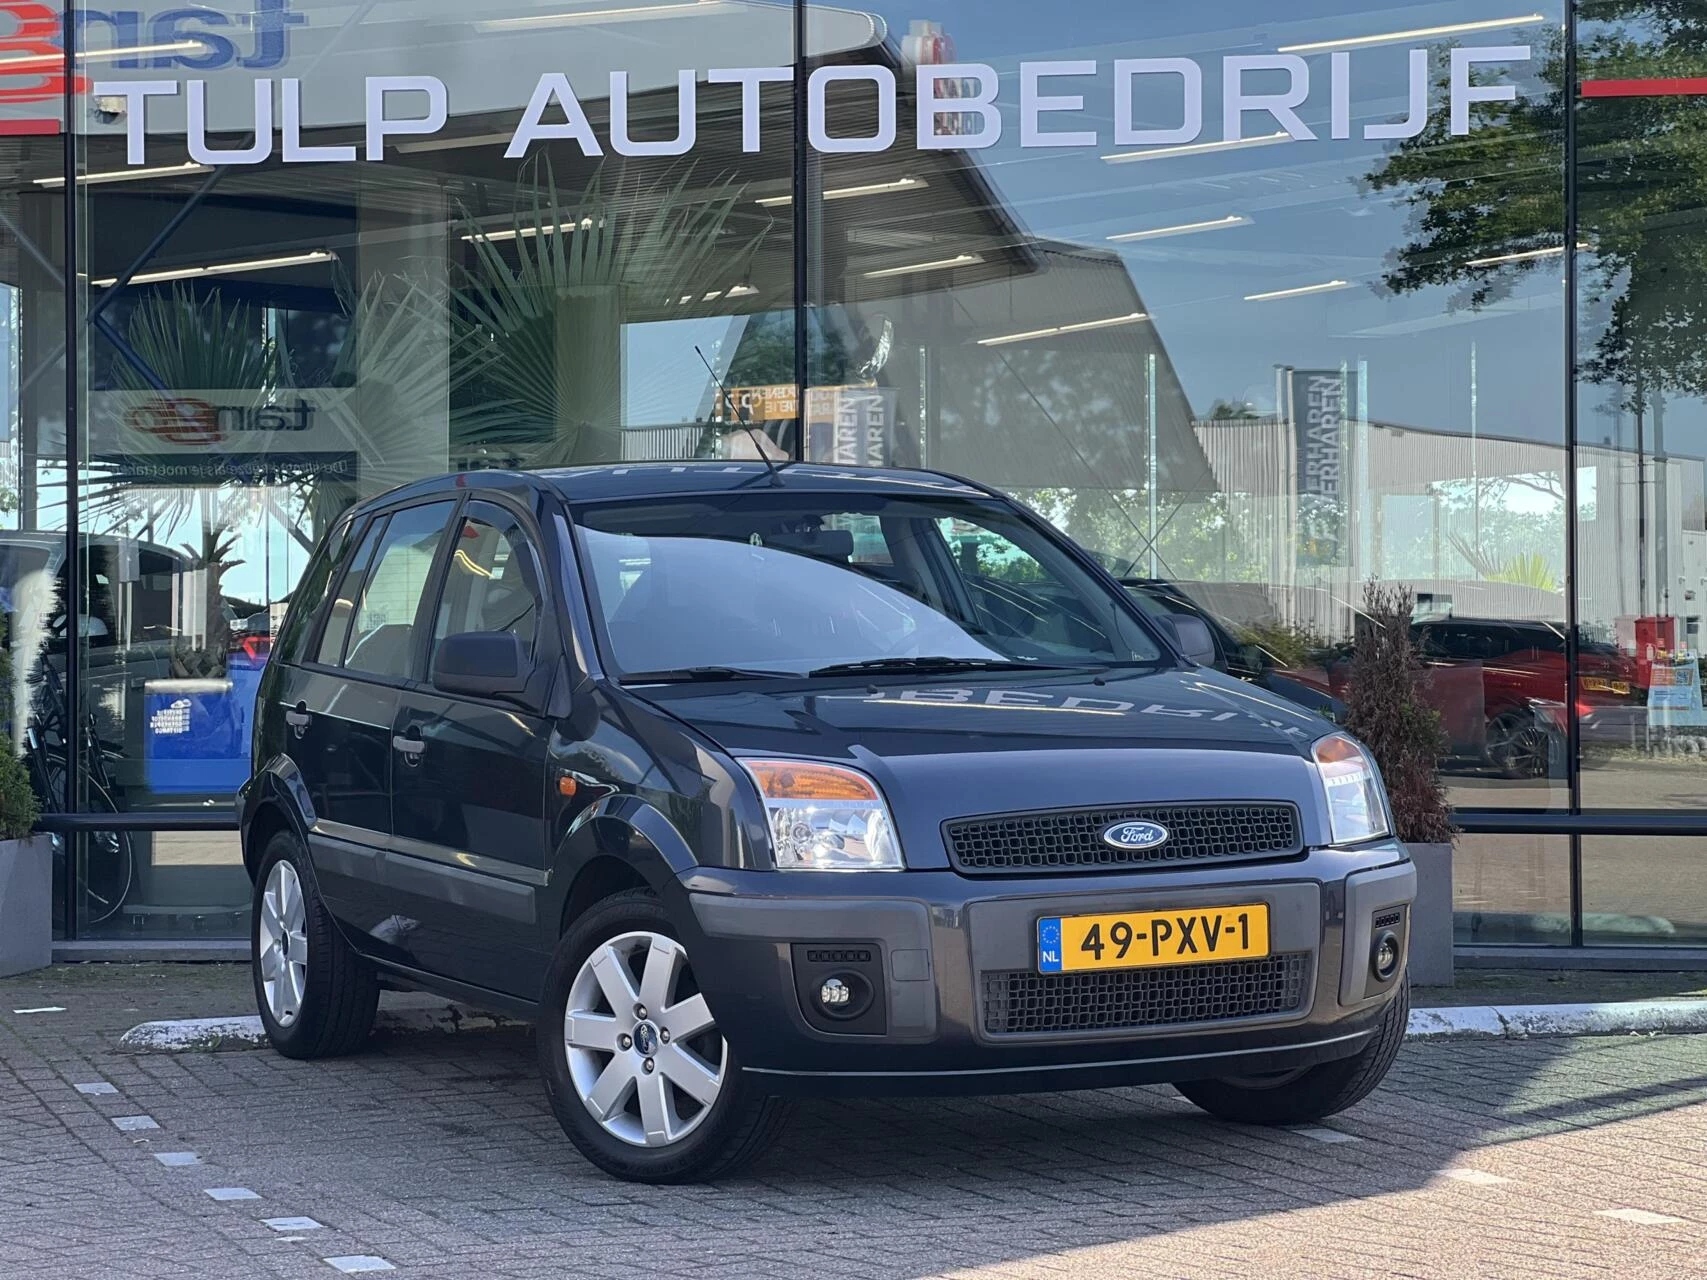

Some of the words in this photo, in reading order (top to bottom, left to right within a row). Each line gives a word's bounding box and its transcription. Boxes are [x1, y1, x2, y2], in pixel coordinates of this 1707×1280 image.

[93, 75, 448, 166] TULP
[503, 45, 1532, 158] AUTOBEDRIJF
[1120, 826, 1154, 843] Ford
[1080, 912, 1249, 961] 49-PXV-1
[1042, 950, 1060, 963] NL
